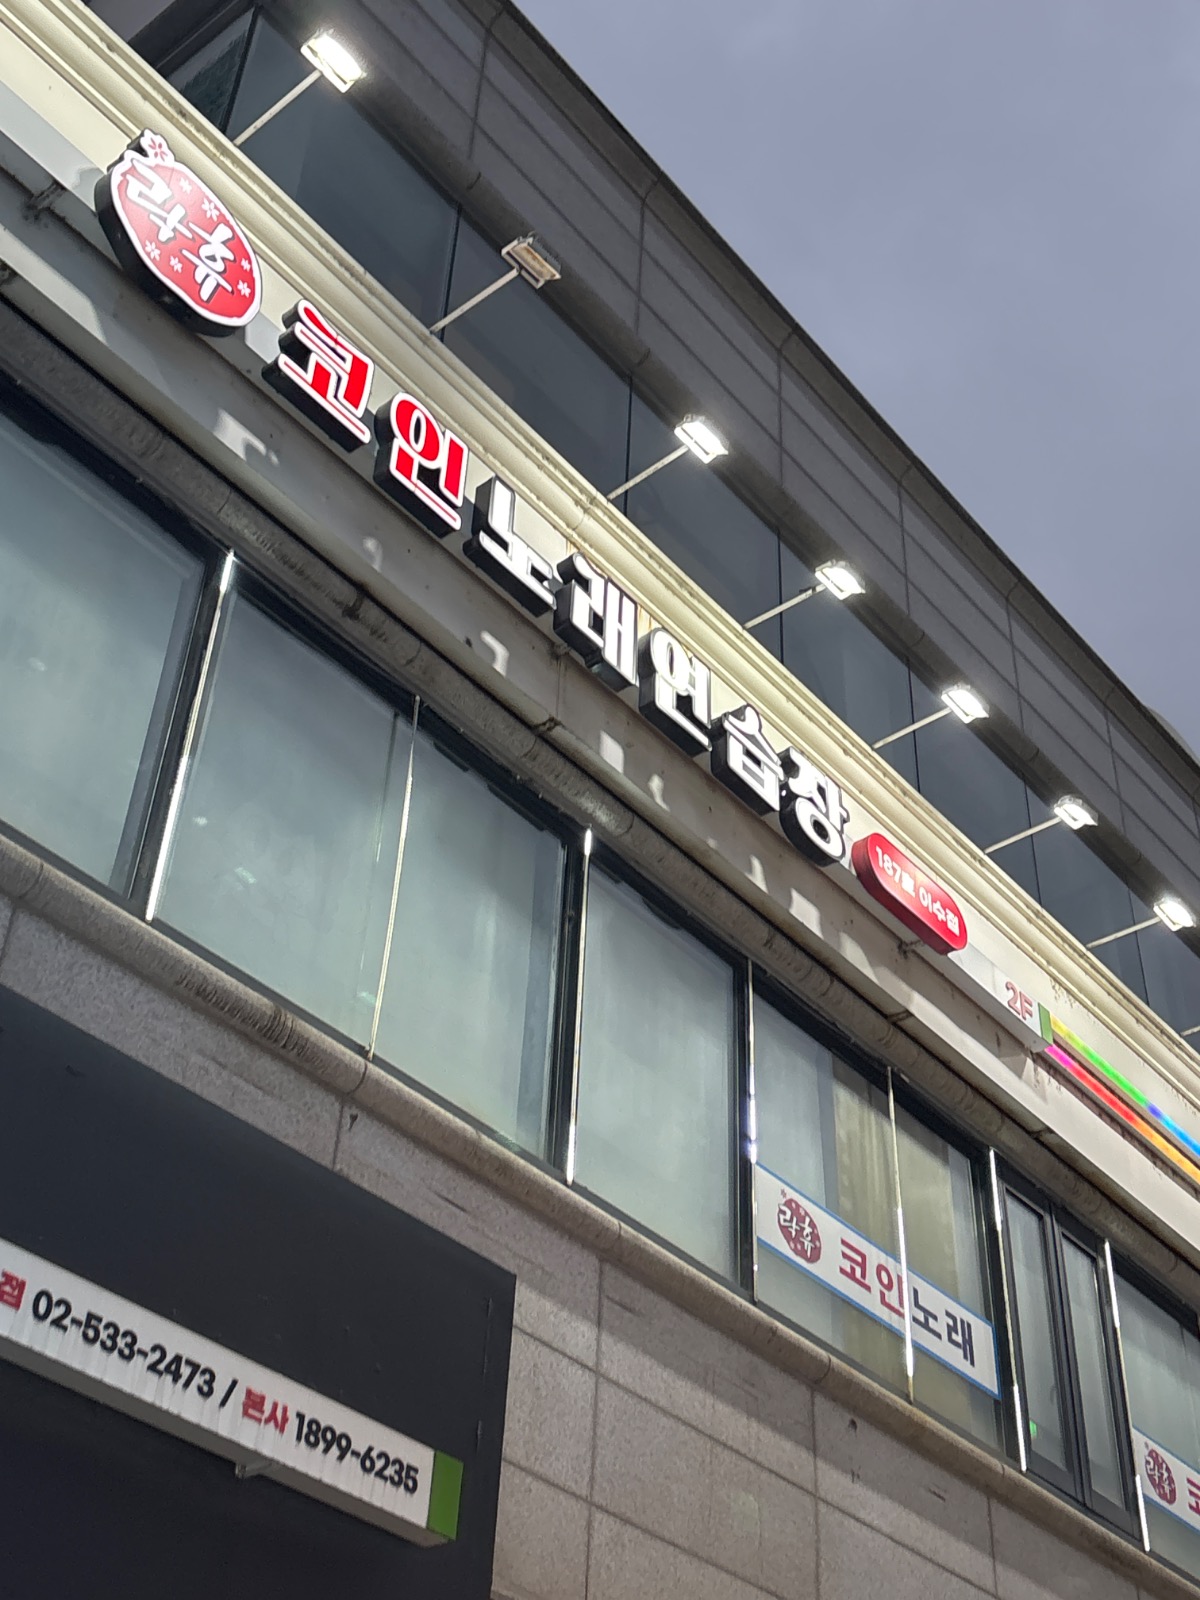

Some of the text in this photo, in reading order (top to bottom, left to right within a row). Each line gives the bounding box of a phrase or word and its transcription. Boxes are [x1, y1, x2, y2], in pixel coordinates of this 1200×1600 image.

[1004, 981, 1034, 1021] 2F
[32, 1289, 216, 1399] 02-533-2473
[242, 1386, 290, 1435] 본사
[294, 1410, 419, 1495] 1899-6235
